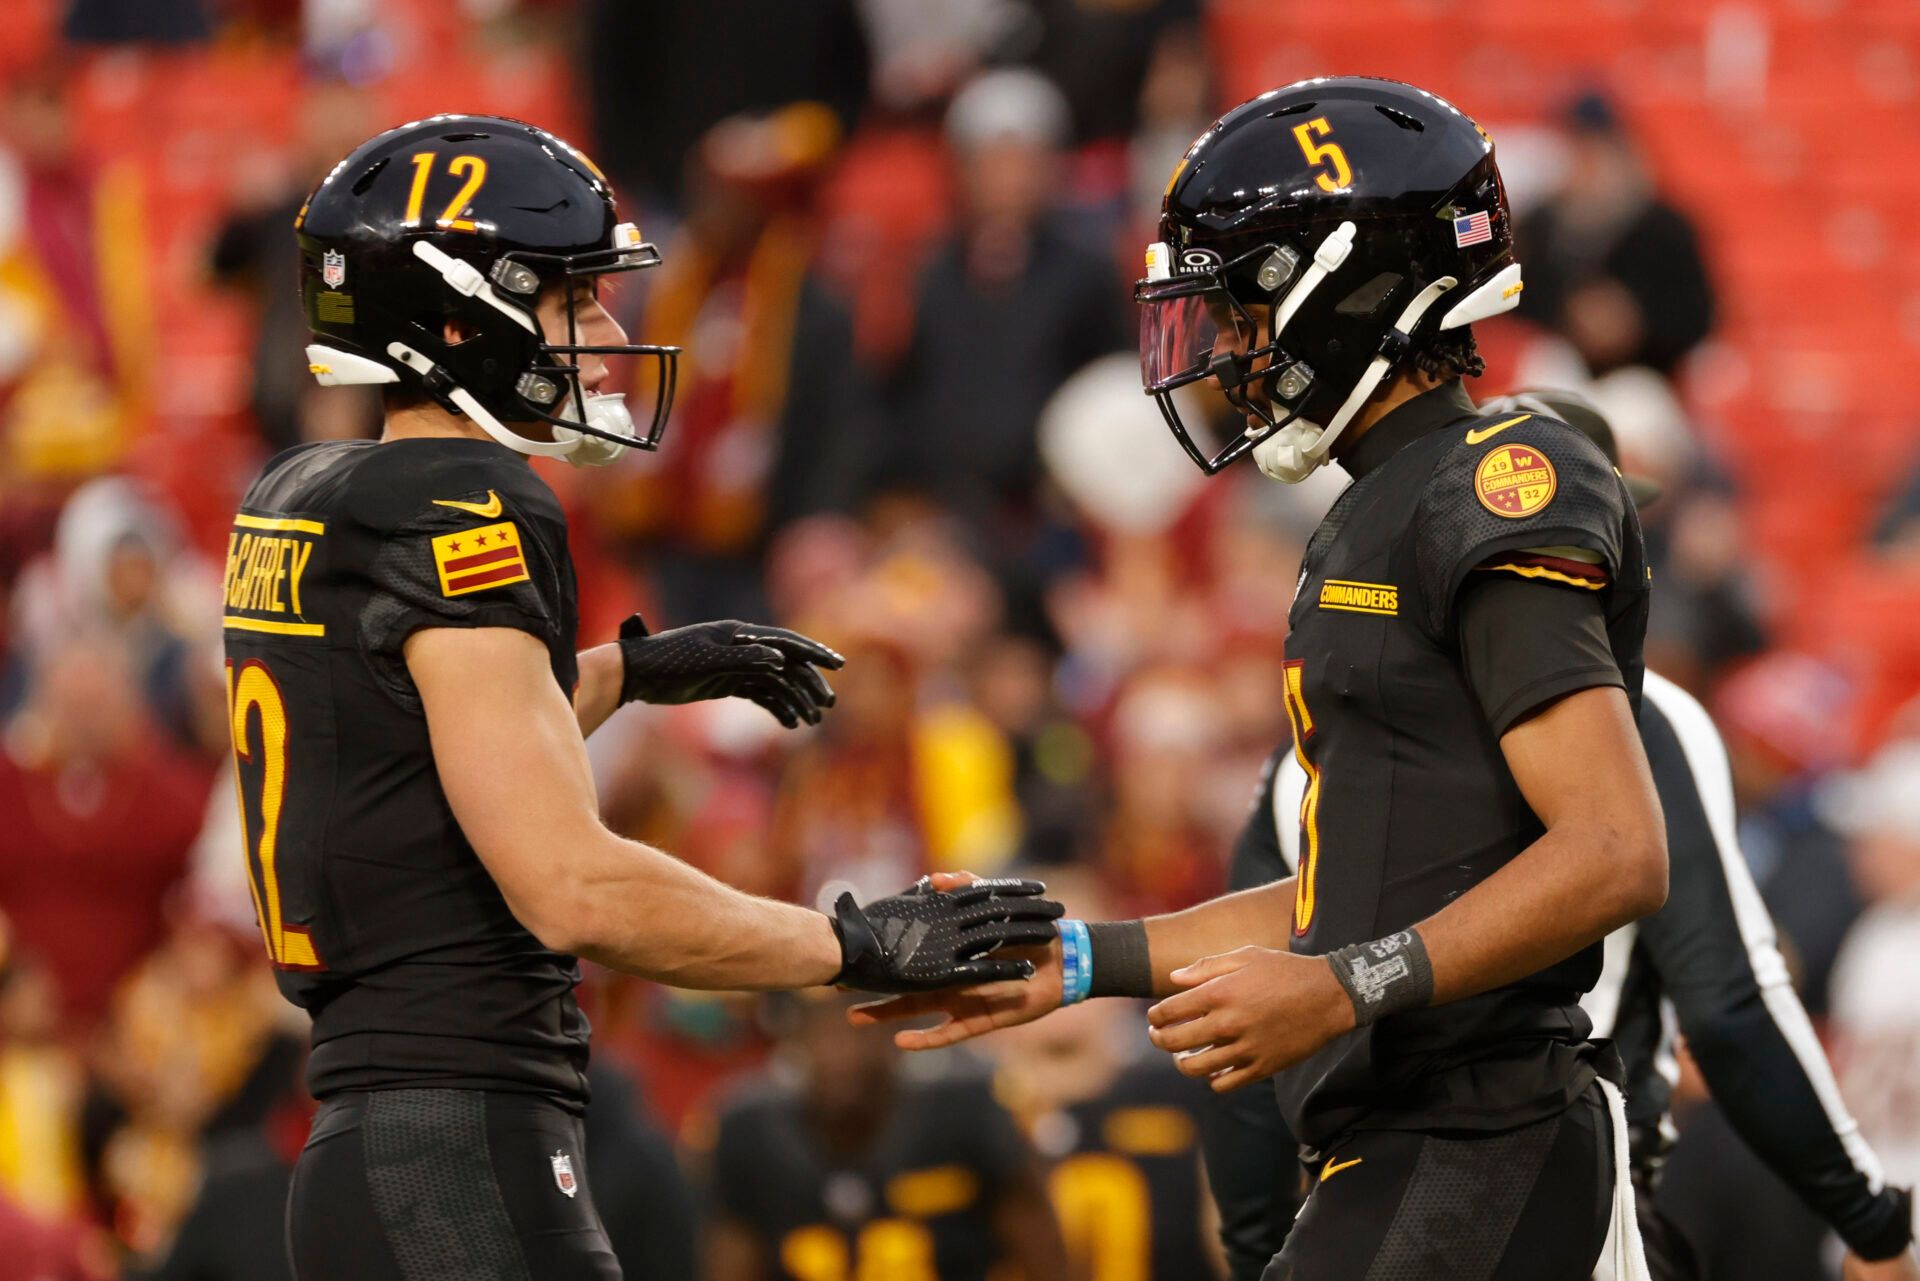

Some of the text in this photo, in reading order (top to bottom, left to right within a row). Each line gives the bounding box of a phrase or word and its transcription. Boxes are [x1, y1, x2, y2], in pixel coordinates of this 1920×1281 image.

[1290, 116, 1354, 194] 5
[402, 151, 488, 233] 12
[1492, 461, 1507, 473] 19
[1483, 470, 1549, 492] COMMANDERS
[1524, 489, 1540, 500] 32
[1320, 584, 1398, 610] COMMANDERS
